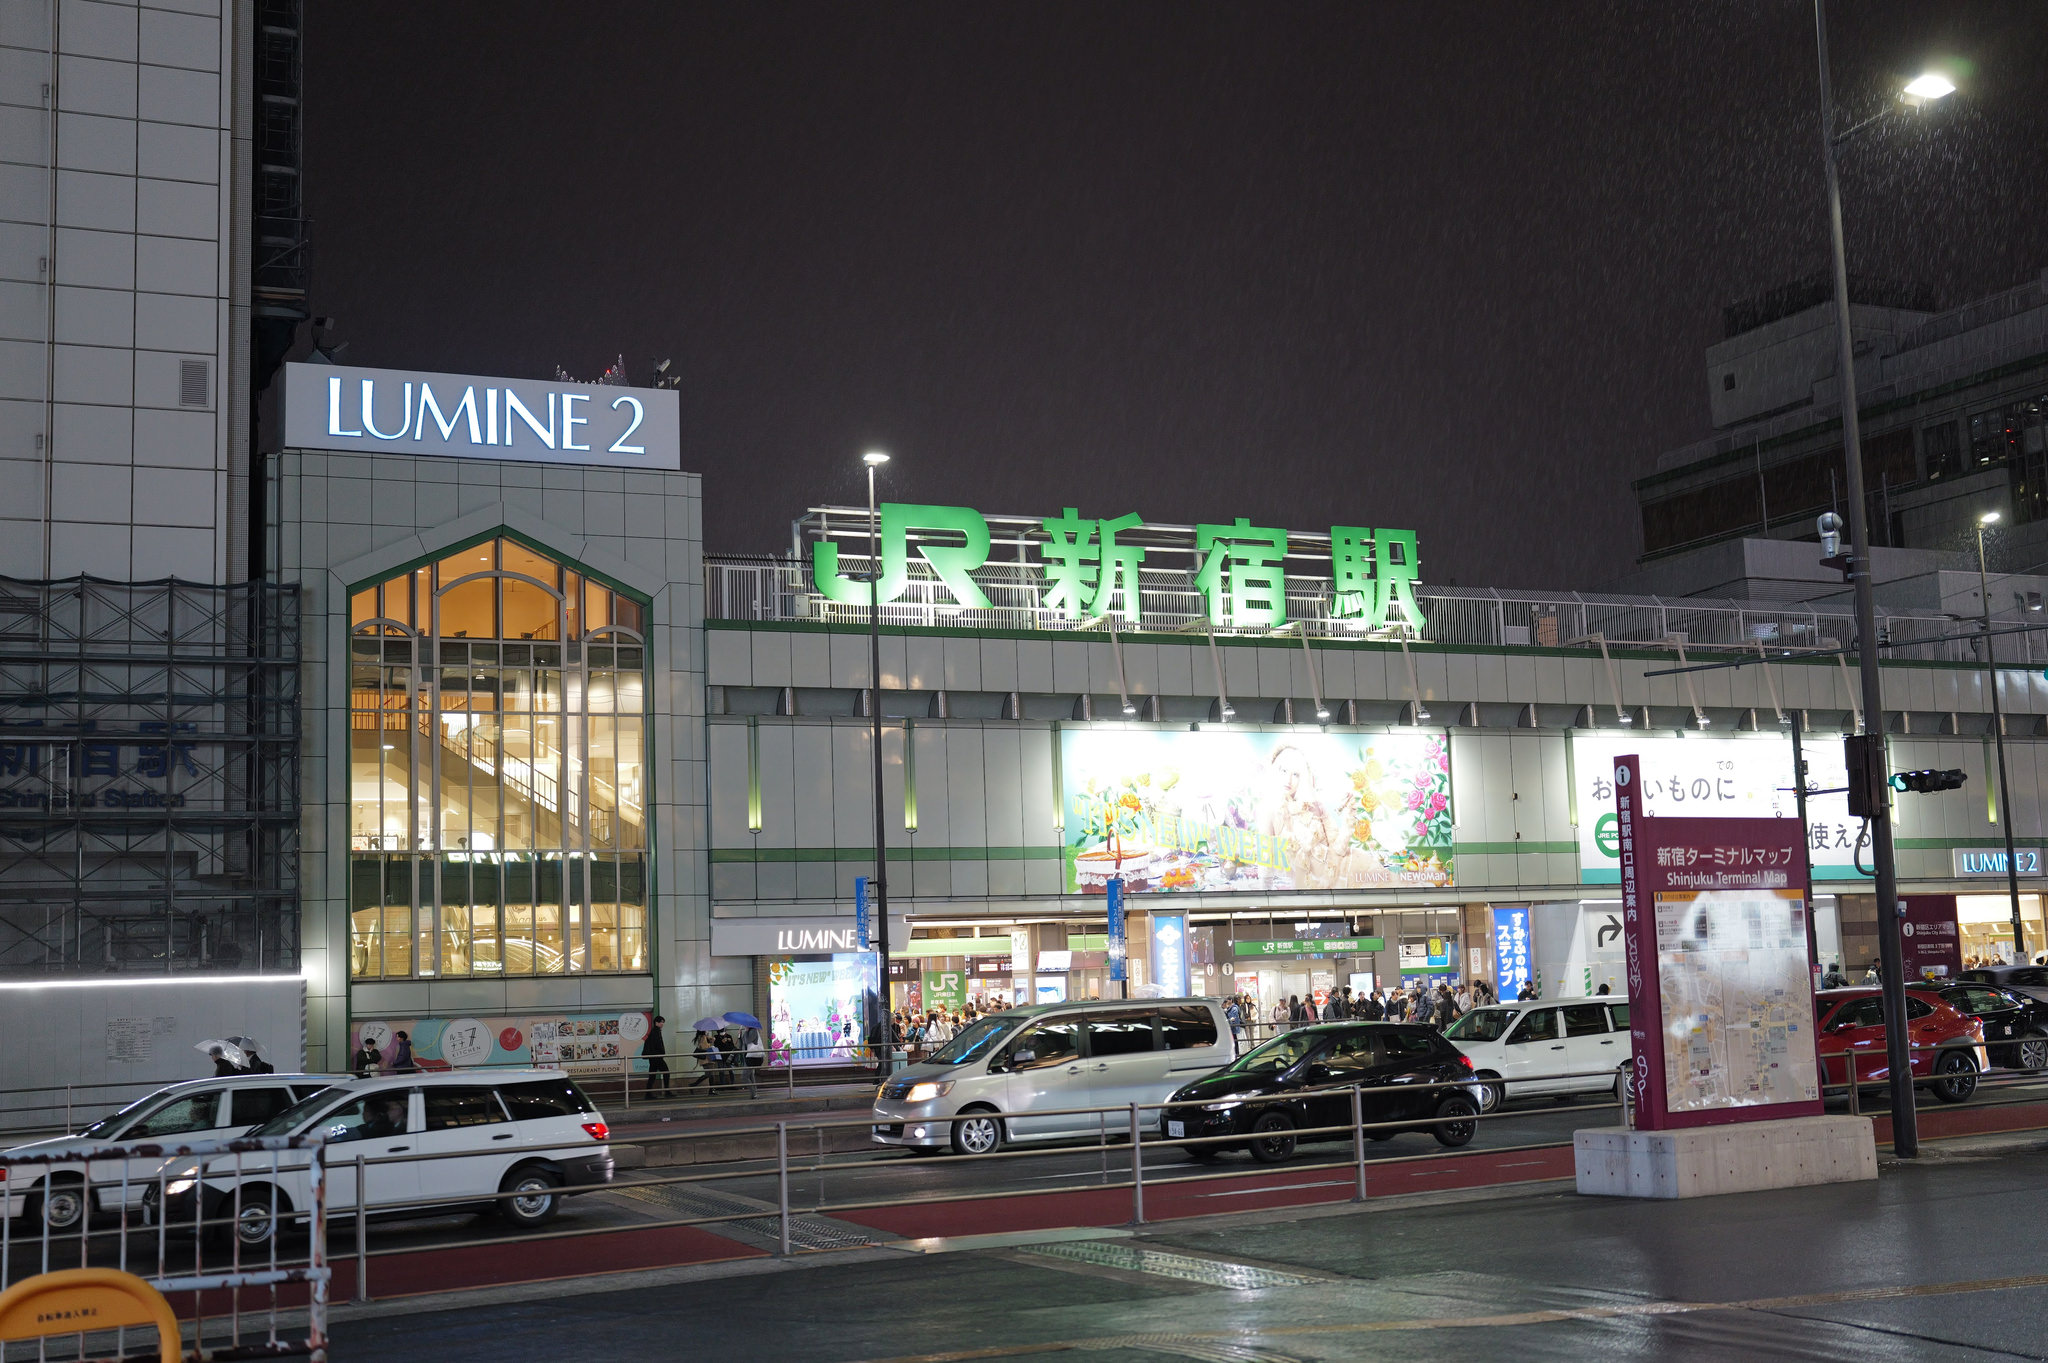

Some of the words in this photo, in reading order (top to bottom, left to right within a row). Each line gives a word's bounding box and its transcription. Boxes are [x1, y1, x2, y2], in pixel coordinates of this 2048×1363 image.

[328, 376, 591, 451] LUMINE
[607, 396, 646, 454] 2
[1716, 760, 1734, 770] での
[104, 787, 186, 808] Station
[1592, 775, 1736, 802] おいものに
[1214, 825, 1292, 872] WEEK
[1619, 795, 1637, 922] 新宿駅南口周辺案内
[1657, 846, 1793, 867] 新宿ターミナルマップ
[2027, 852, 2038, 872] 2
[1355, 872, 1389, 883] LUMINE
[1400, 872, 1447, 881] NEWoMan
[1666, 870, 1714, 889] Shinjuku
[1716, 870, 1761, 885] Terminal
[1764, 871, 1788, 887] Map
[777, 929, 857, 950] LUMINE
[1262, 942, 1275, 951] JR
[1497, 925, 1514, 988] ステップ
[930, 974, 958, 991] JR
[452, 1045, 481, 1057] KITCHEN
